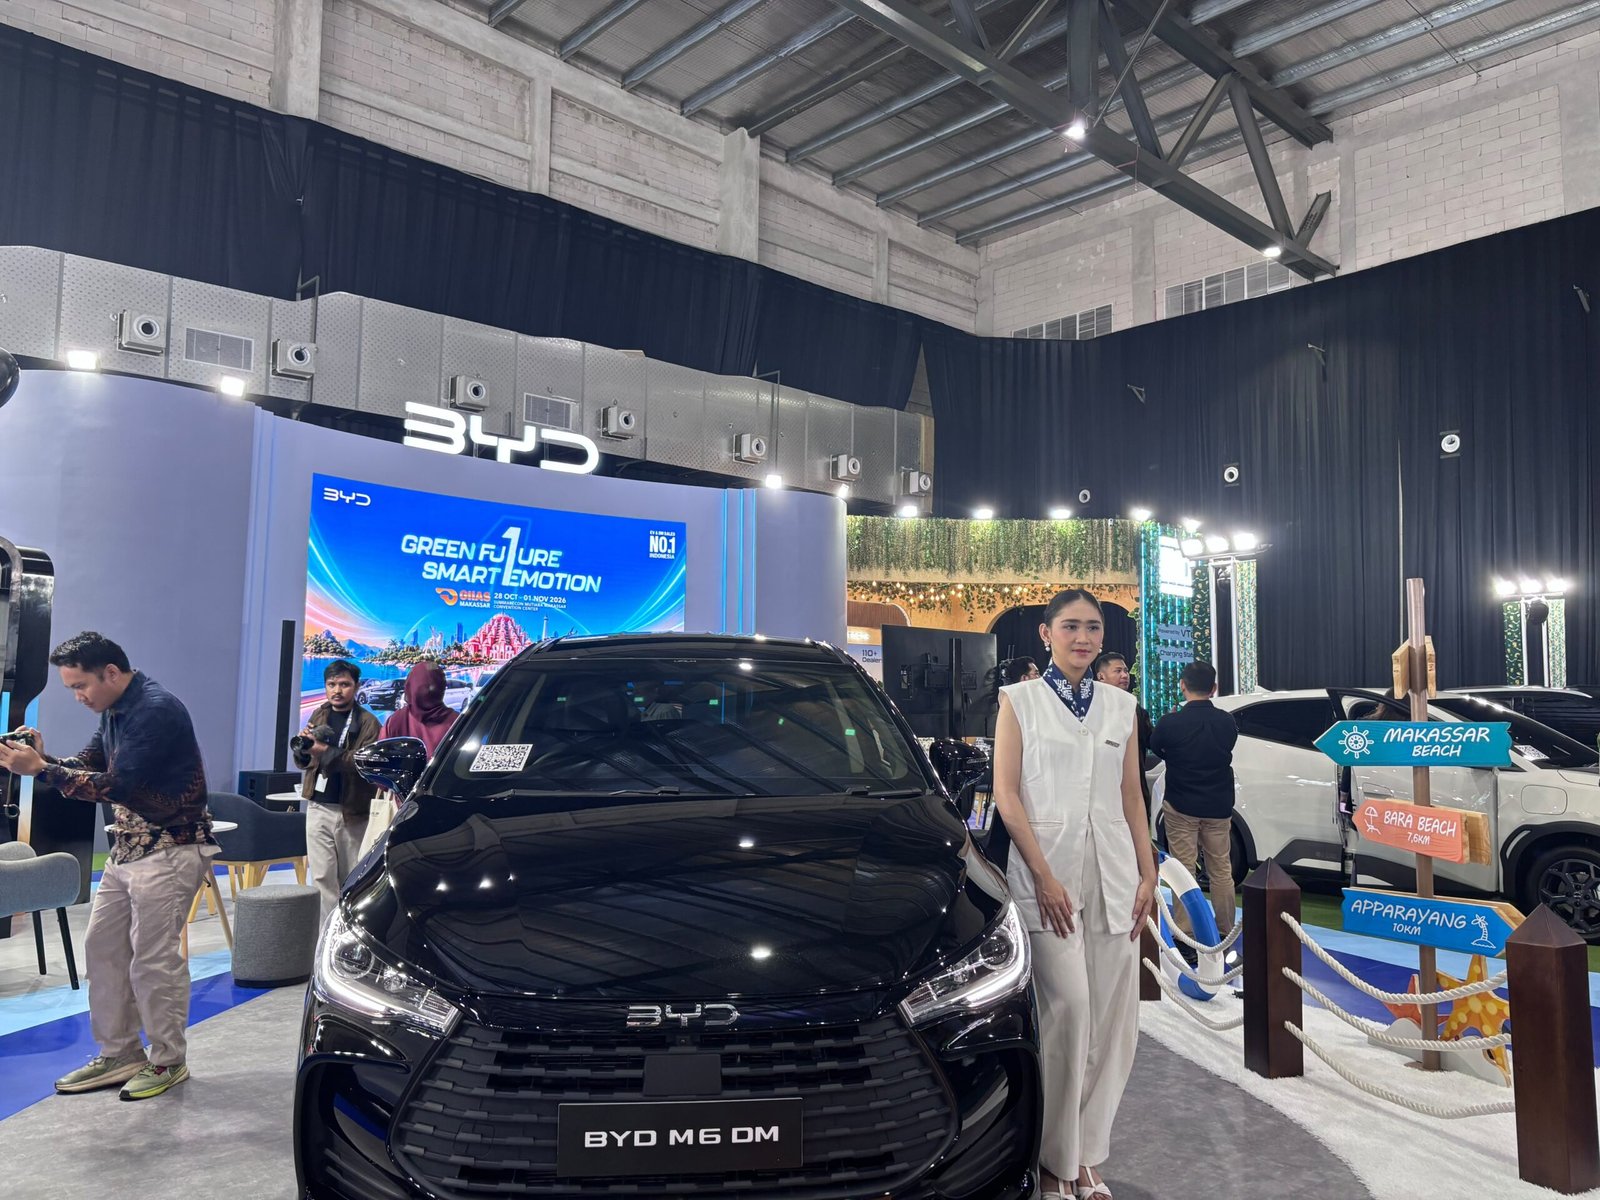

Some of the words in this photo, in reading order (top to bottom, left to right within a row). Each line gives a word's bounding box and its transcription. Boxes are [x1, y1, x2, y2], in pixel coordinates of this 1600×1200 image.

[404, 401, 599, 474] BYD
[323, 487, 371, 506] BYD
[401, 534, 476, 560] GREEN
[649, 535, 675, 554] NO.1
[422, 561, 501, 586] SMART
[508, 569, 601, 593] EMOTION
[460, 590, 491, 602] GIIAS
[862, 649, 878, 657] 110+
[1160, 649, 1183, 658] Charging
[1383, 726, 1490, 743] MAKASSAR
[1411, 745, 1462, 757] BEACH
[1383, 810, 1413, 829] BARA
[1417, 815, 1457, 837] BEACH
[1351, 899, 1467, 929] APPARAYANG
[1393, 923, 1421, 936] 10KM
[626, 1003, 740, 1028] BYD
[584, 1130, 657, 1148] BYD
[669, 1128, 721, 1146] M6
[731, 1126, 779, 1144] DM
